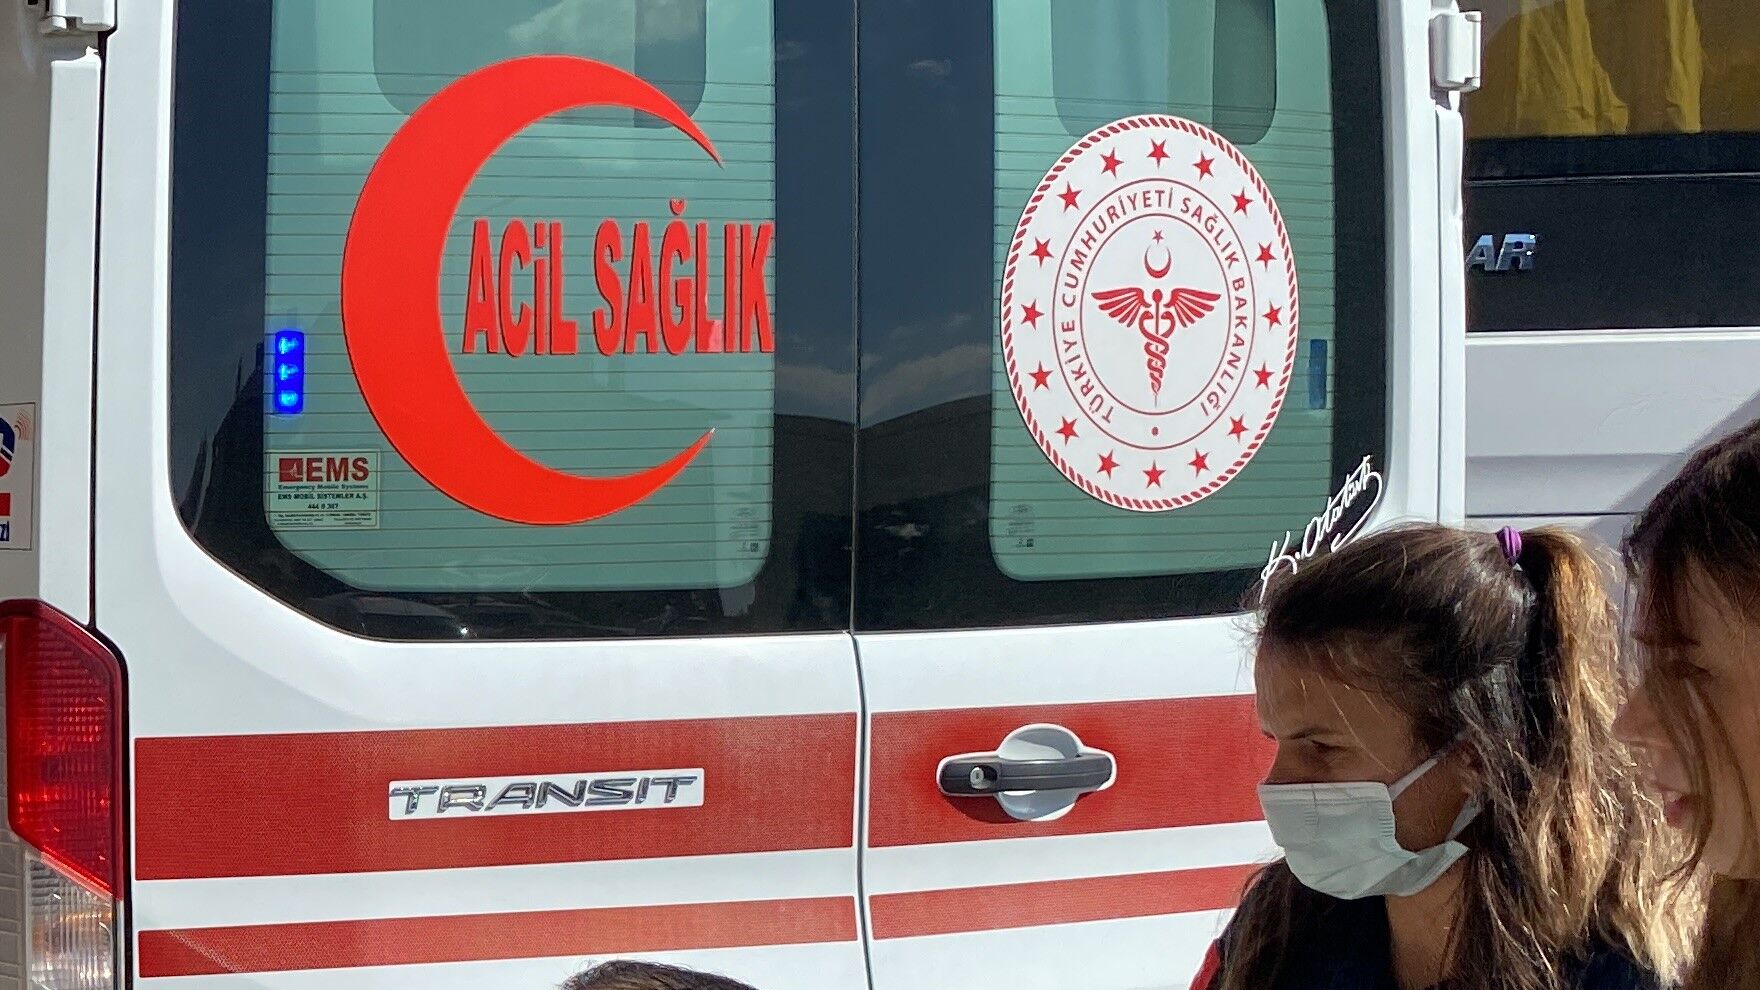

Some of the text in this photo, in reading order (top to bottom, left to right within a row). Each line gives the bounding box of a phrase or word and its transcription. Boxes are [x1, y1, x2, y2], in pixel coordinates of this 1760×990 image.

[592, 198, 775, 357] SAĞLIK
[1061, 187, 1248, 424] TÜRKİYE CUMHURİYETİ SAĞLIK BAKANLIĞI
[306, 457, 370, 482] EMS
[390, 775, 699, 816] TRANSIT
